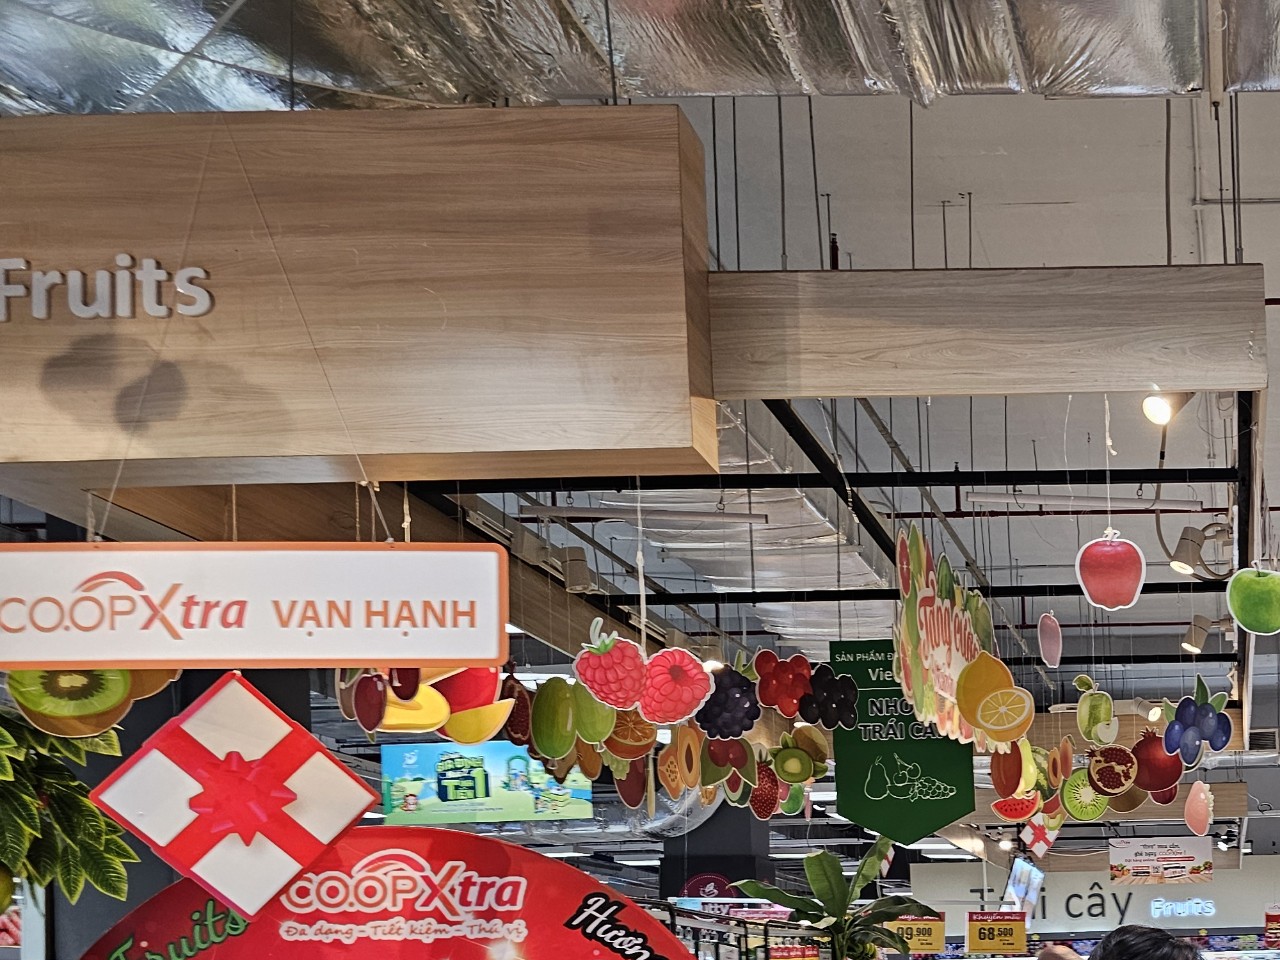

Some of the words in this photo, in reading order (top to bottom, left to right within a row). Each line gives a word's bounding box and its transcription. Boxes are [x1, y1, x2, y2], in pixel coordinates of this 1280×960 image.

[0, 253, 212, 321] Fruits
[272, 600, 352, 637] VẠN
[365, 600, 477, 638] HẠNH
[835, 652, 854, 662] SẢN
[855, 649, 885, 662] PHẨM
[858, 722, 905, 741] TRÁI
[1065, 882, 1133, 925] cây
[1150, 897, 1216, 918] Fruits
[972, 912, 1004, 922] Khuyến
[284, 925, 306, 937] Đa
[313, 924, 354, 942] dạng
[371, 920, 404, 935] Tiết
[410, 923, 450, 941] kiệm
